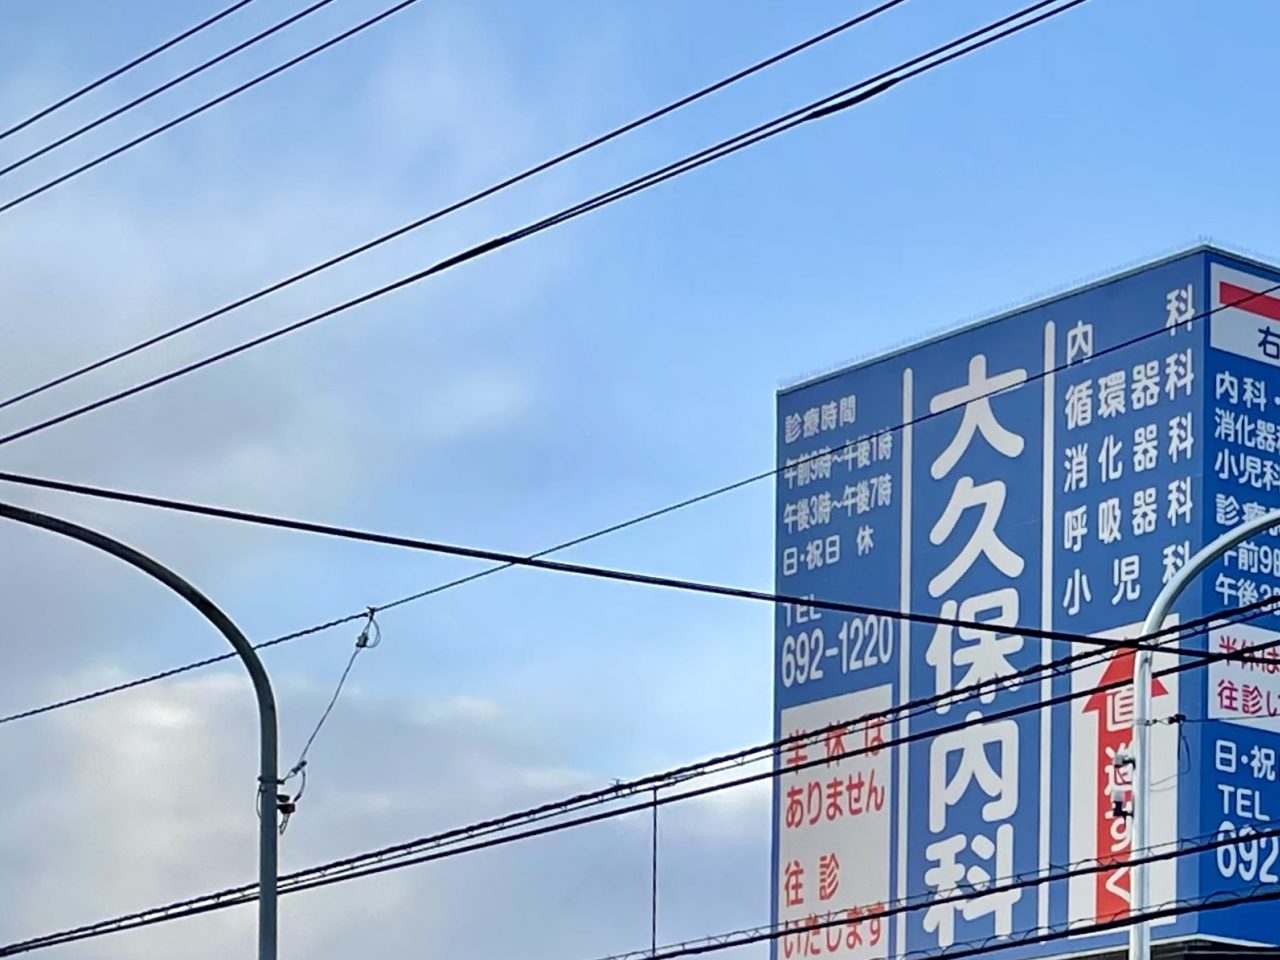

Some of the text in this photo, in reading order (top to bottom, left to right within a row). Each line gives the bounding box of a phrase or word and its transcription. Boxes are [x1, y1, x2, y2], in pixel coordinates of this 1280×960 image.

[784, 394, 857, 444] 診療時間
[1064, 348, 1195, 432] 循環器科
[1064, 412, 1194, 493] 消化器科
[856, 525, 875, 556] 休
[1064, 477, 1193, 553] 呼吸器科
[782, 593, 822, 628] TEL
[1063, 540, 1190, 616] 小児科
[782, 614, 893, 688] 692-1220
[923, 354, 1028, 948] 大久保内科
[785, 769, 886, 829] ありません
[1218, 785, 1270, 822] TEL
[784, 901, 886, 959] いたします
